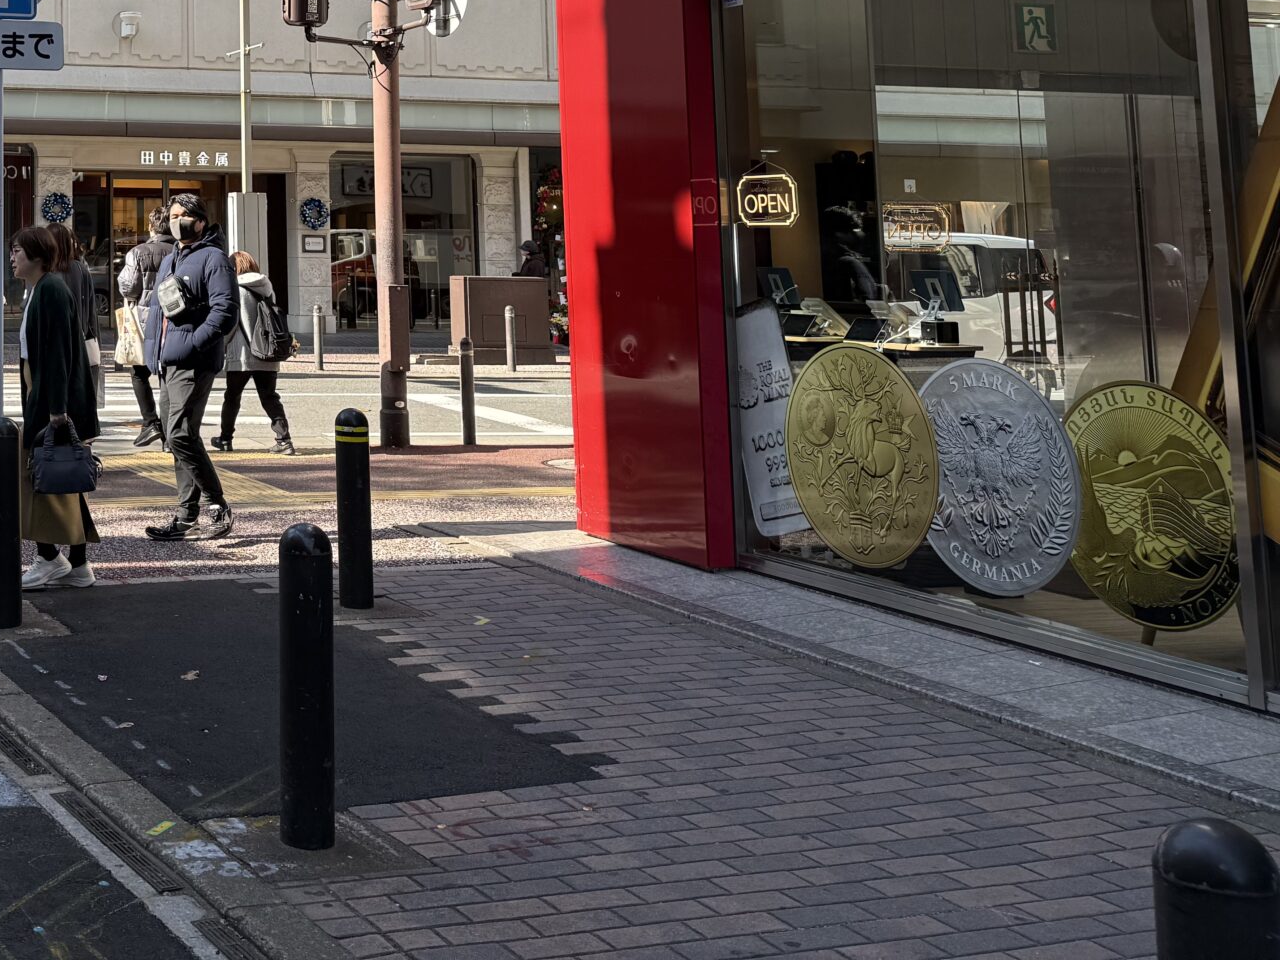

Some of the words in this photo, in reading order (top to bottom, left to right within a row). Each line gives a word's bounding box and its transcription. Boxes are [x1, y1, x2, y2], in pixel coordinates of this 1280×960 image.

[140, 150, 229, 167] 田中貴金属
[744, 192, 790, 214] OPEN
[756, 360, 773, 373] THE
[759, 368, 790, 388] ROYAL
[961, 371, 1020, 401] MARK
[759, 383, 790, 403] MINT
[949, 541, 1043, 582] GERMANIA
